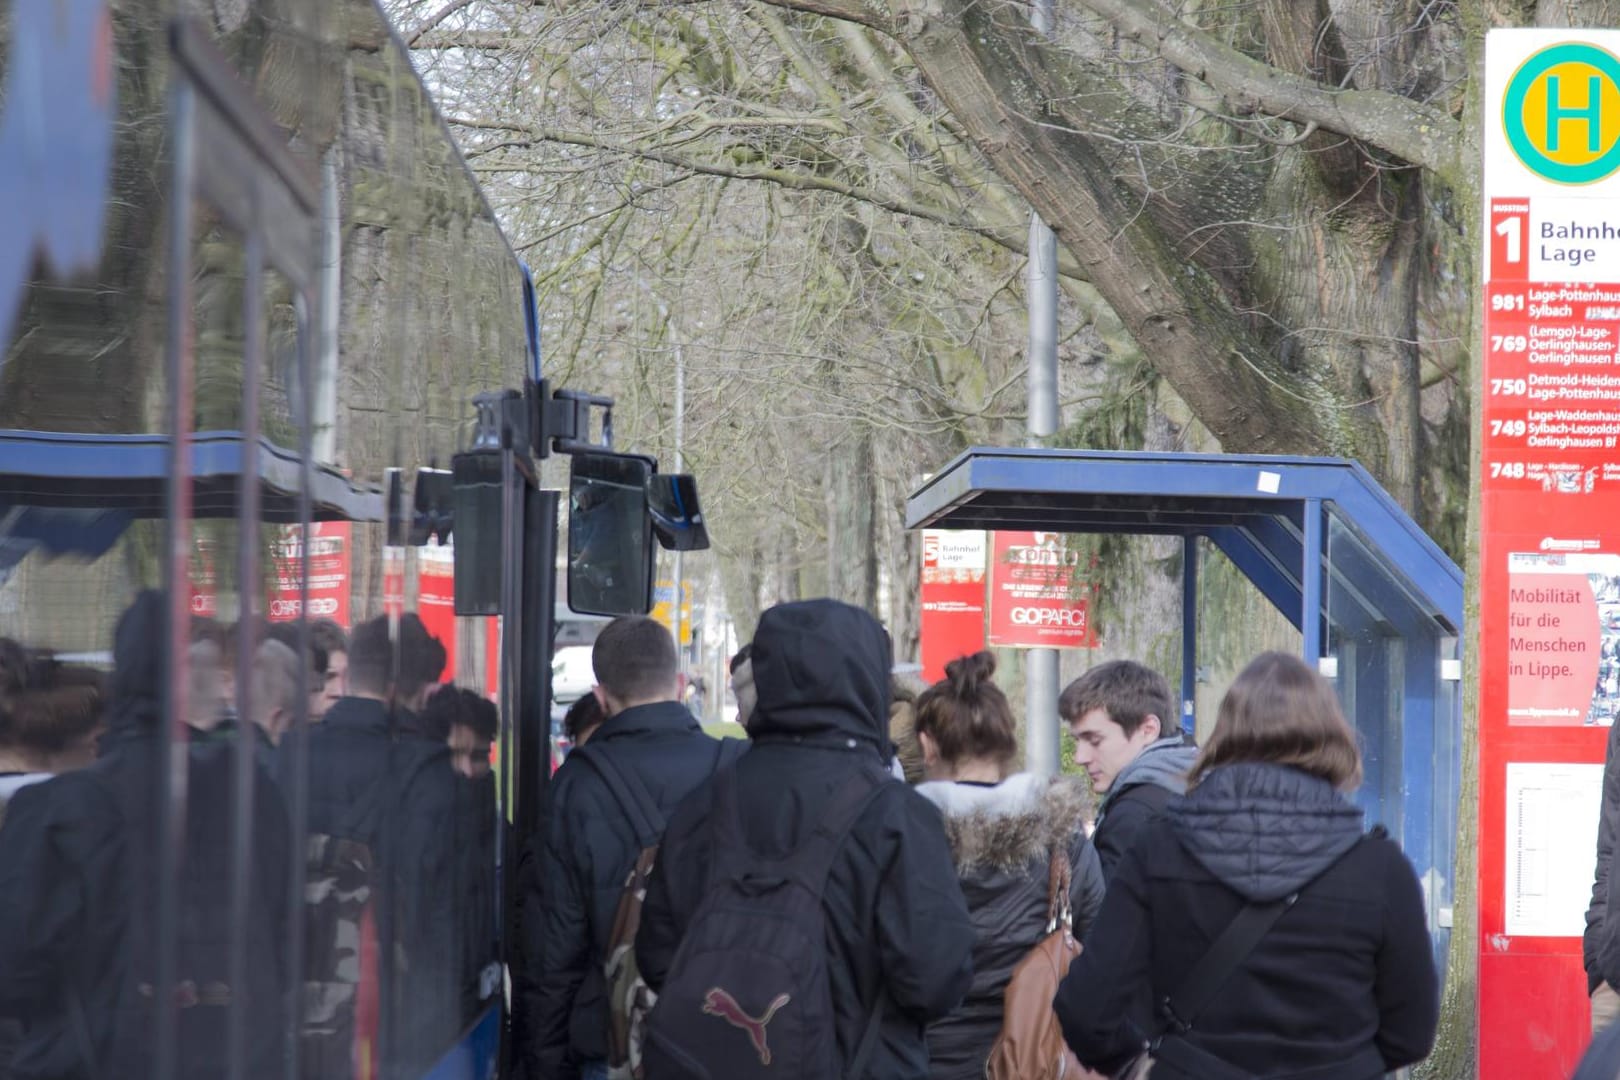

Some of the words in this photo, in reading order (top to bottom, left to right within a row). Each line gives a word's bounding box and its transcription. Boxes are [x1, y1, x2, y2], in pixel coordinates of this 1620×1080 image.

[1546, 75, 1601, 152] H
[1541, 220, 1620, 239] Bahnh
[1495, 216, 1522, 263] 1
[1541, 244, 1596, 267] Lage
[1491, 294, 1525, 311] 981
[1528, 304, 1573, 320] Sylbach
[1491, 335, 1527, 352] 769
[1528, 351, 1611, 366] Oerlinghausen
[1490, 379, 1526, 395] 750
[1490, 420, 1526, 437] 749
[1528, 436, 1603, 450] Oerlinghausen
[1605, 436, 1617, 448] Bf
[1490, 462, 1525, 478] 748
[942, 544, 980, 553] Bahnhof
[942, 554, 963, 562] Lage
[1510, 589, 1581, 603] Mobilität
[1510, 612, 1532, 627] für
[1537, 612, 1561, 627] die
[1510, 637, 1586, 652] Menschen
[1509, 661, 1523, 676] in
[1528, 661, 1573, 680] Lippe.
